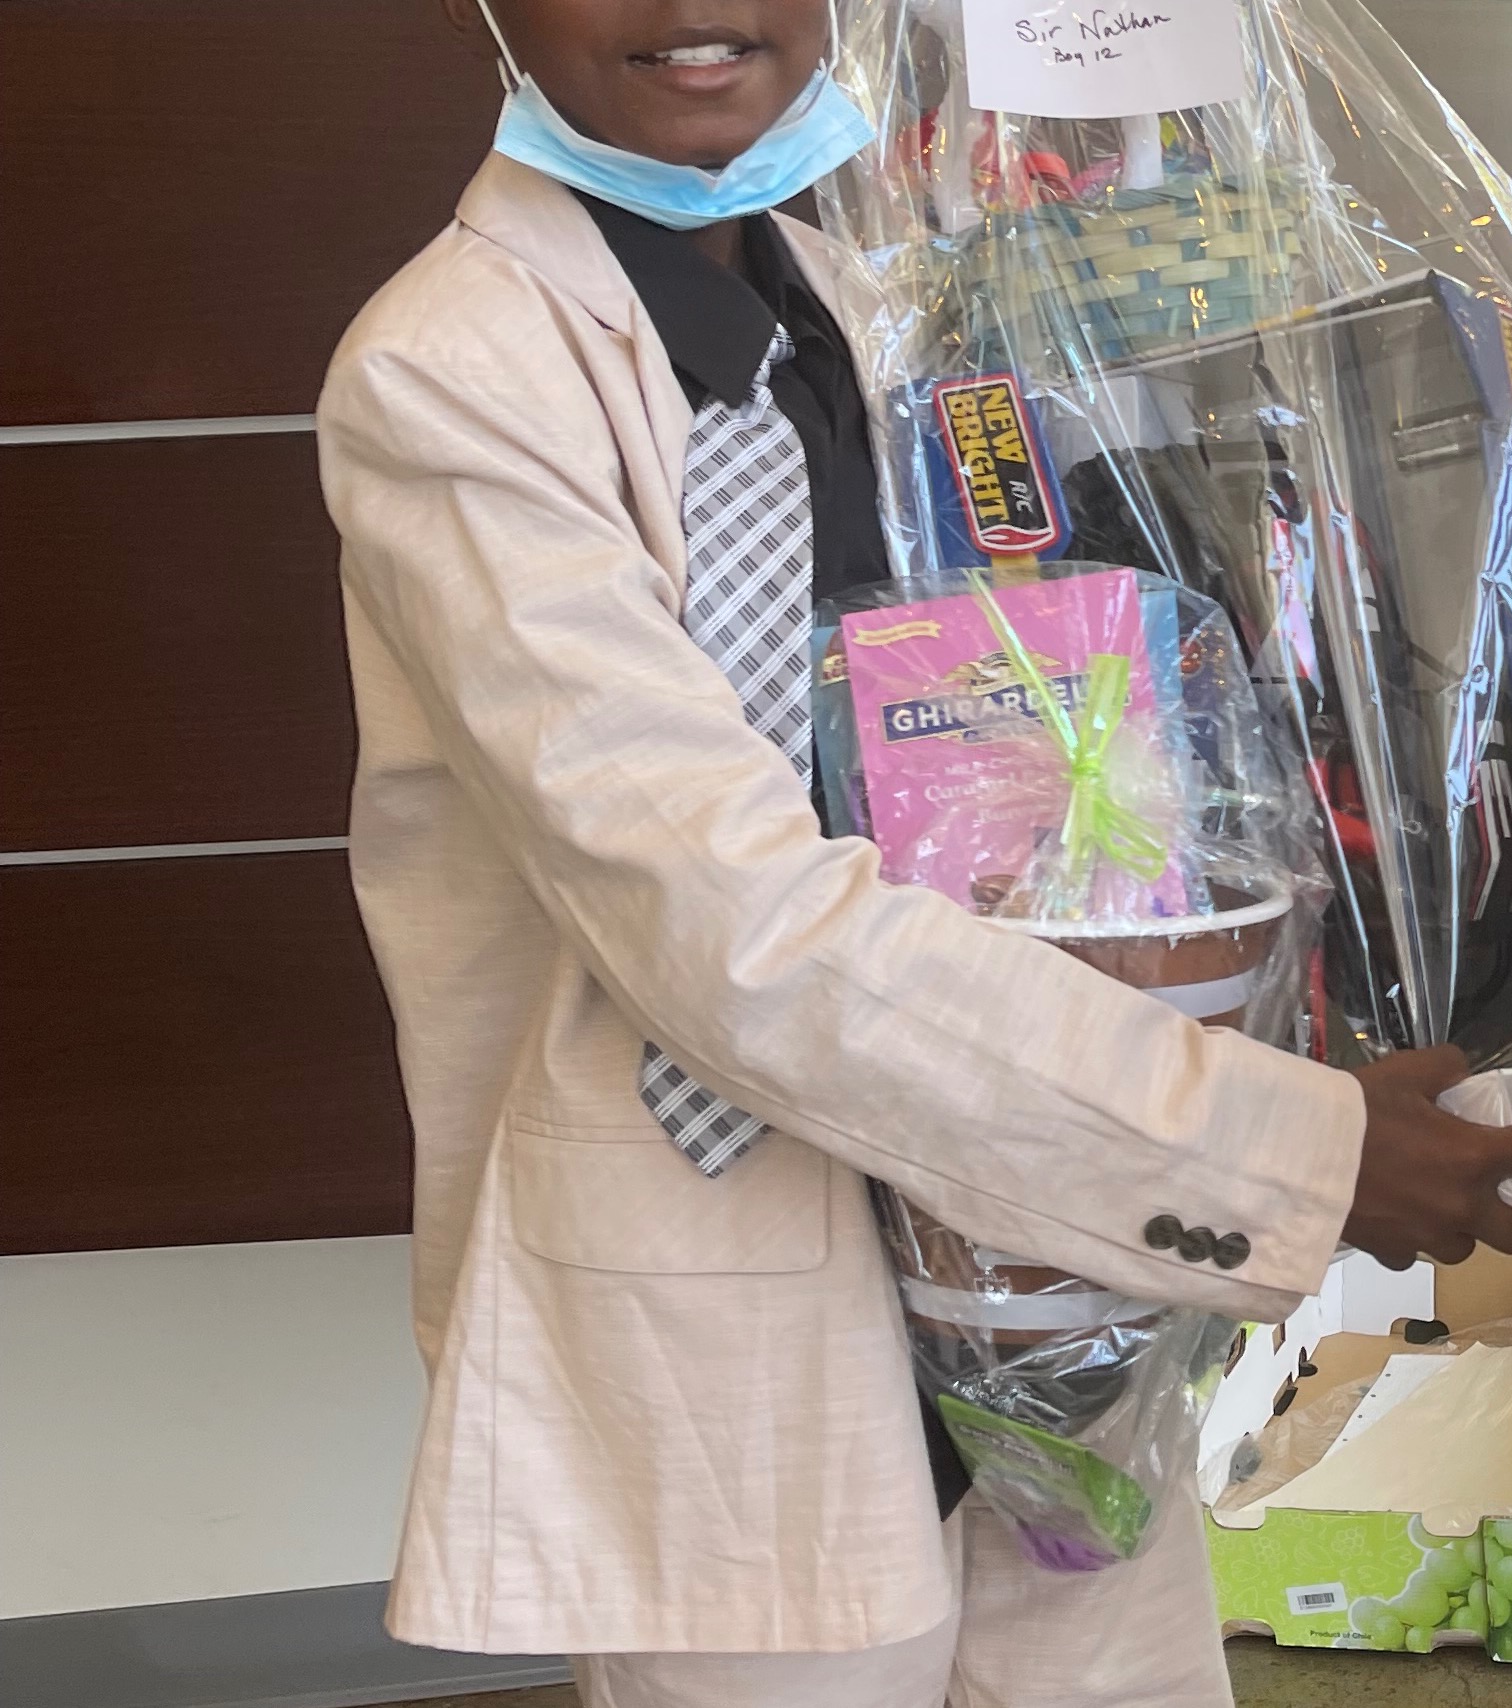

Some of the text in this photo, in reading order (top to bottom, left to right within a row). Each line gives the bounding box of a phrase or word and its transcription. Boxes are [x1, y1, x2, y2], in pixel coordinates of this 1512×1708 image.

[1015, 9, 1171, 43] Sir Nathan
[1052, 47, 1122, 67] Boy 12
[976, 386, 1028, 463] NEW
[946, 392, 1010, 522] BRIGHT
[891, 680, 1094, 732] GHIRARDEL
